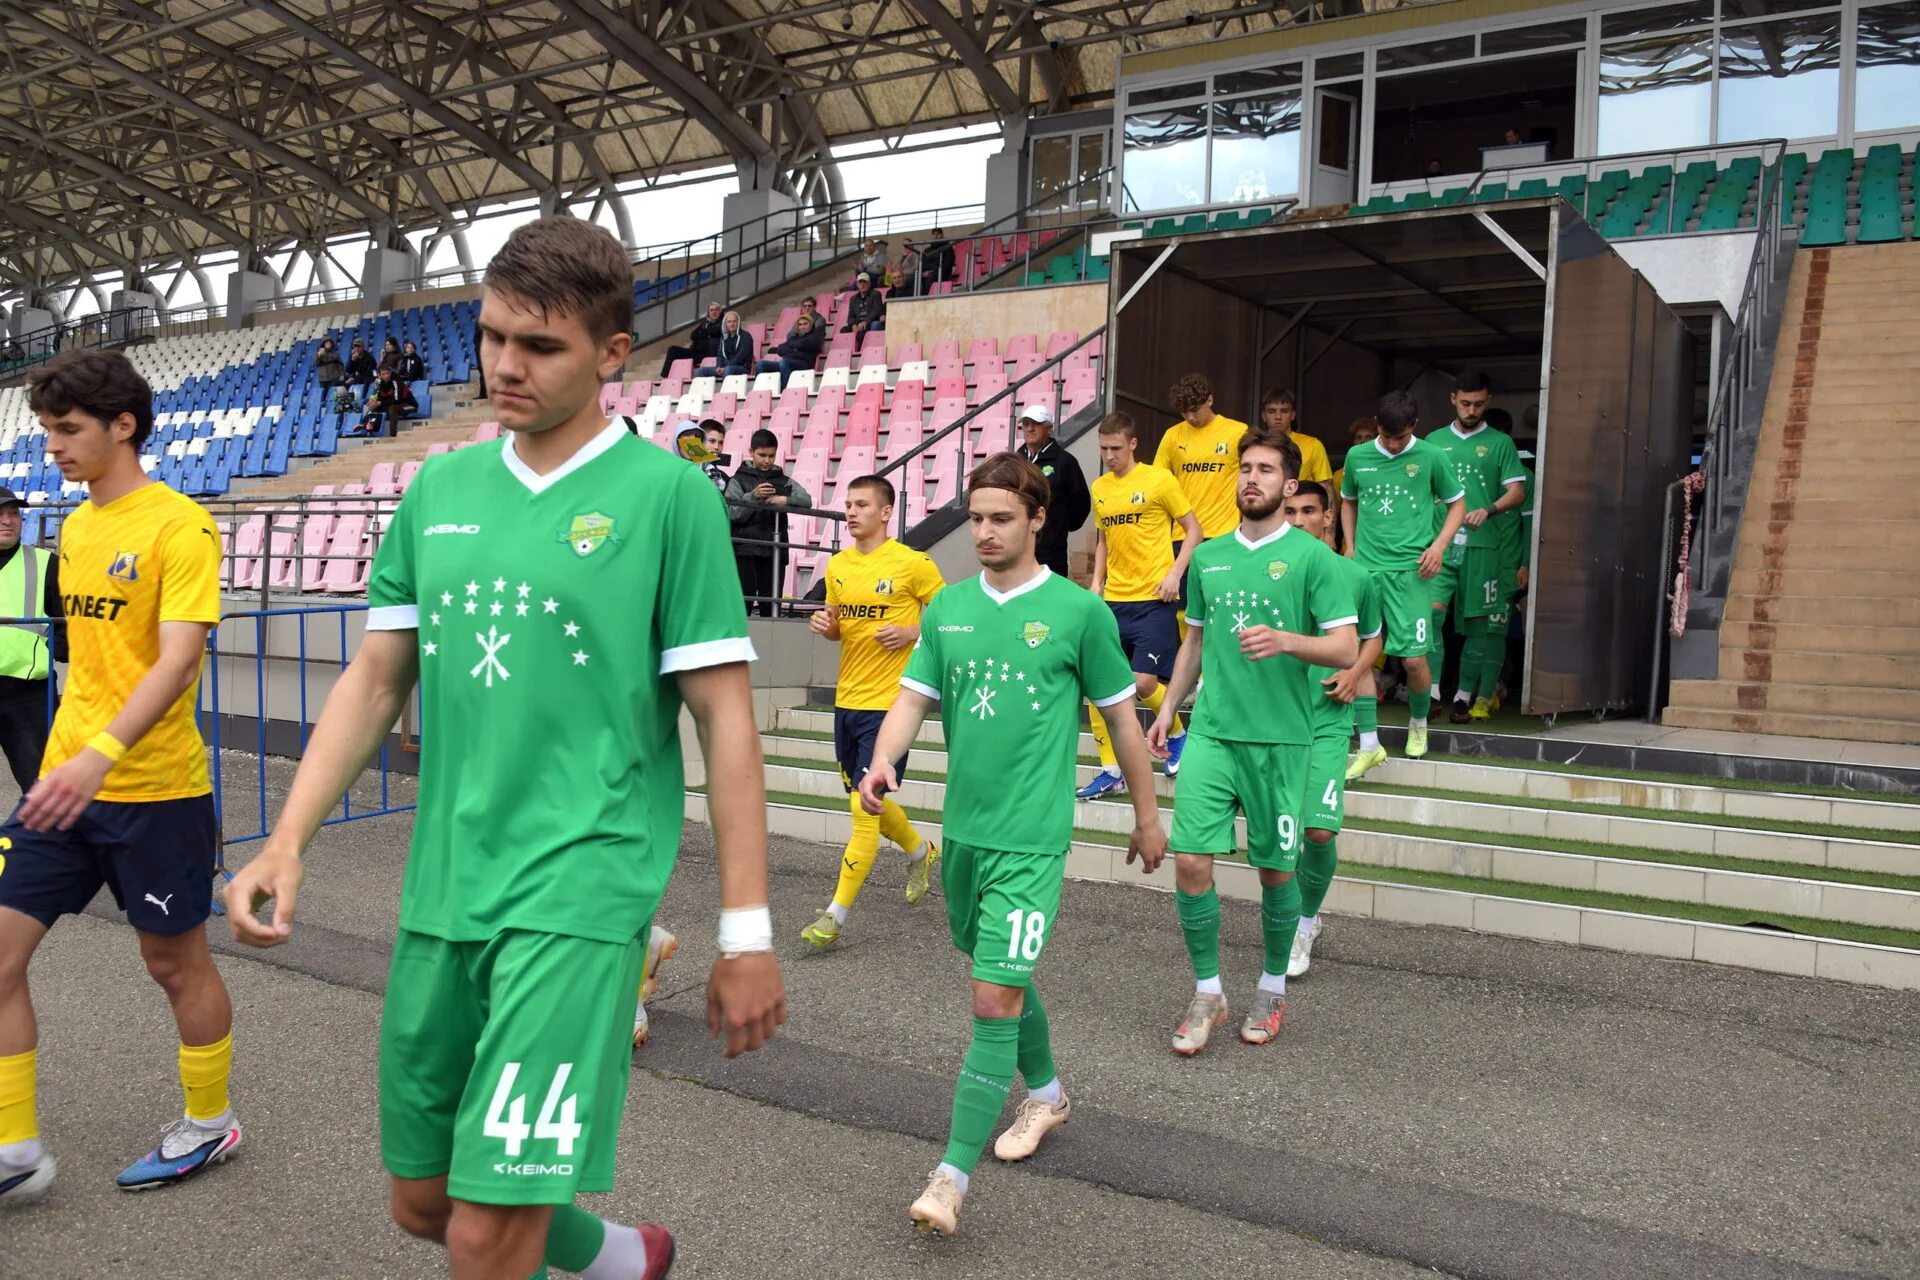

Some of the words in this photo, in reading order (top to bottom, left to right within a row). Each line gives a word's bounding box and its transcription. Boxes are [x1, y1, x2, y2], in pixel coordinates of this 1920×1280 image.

[1483, 580, 1497, 603] 15
[1416, 617, 1426, 643] 8
[1322, 779, 1337, 811] 4
[1006, 908, 1045, 960] 18
[1007, 963, 1035, 972] KEIM
[483, 1062, 582, 1156] 44
[507, 1164, 573, 1175] KEIMO
